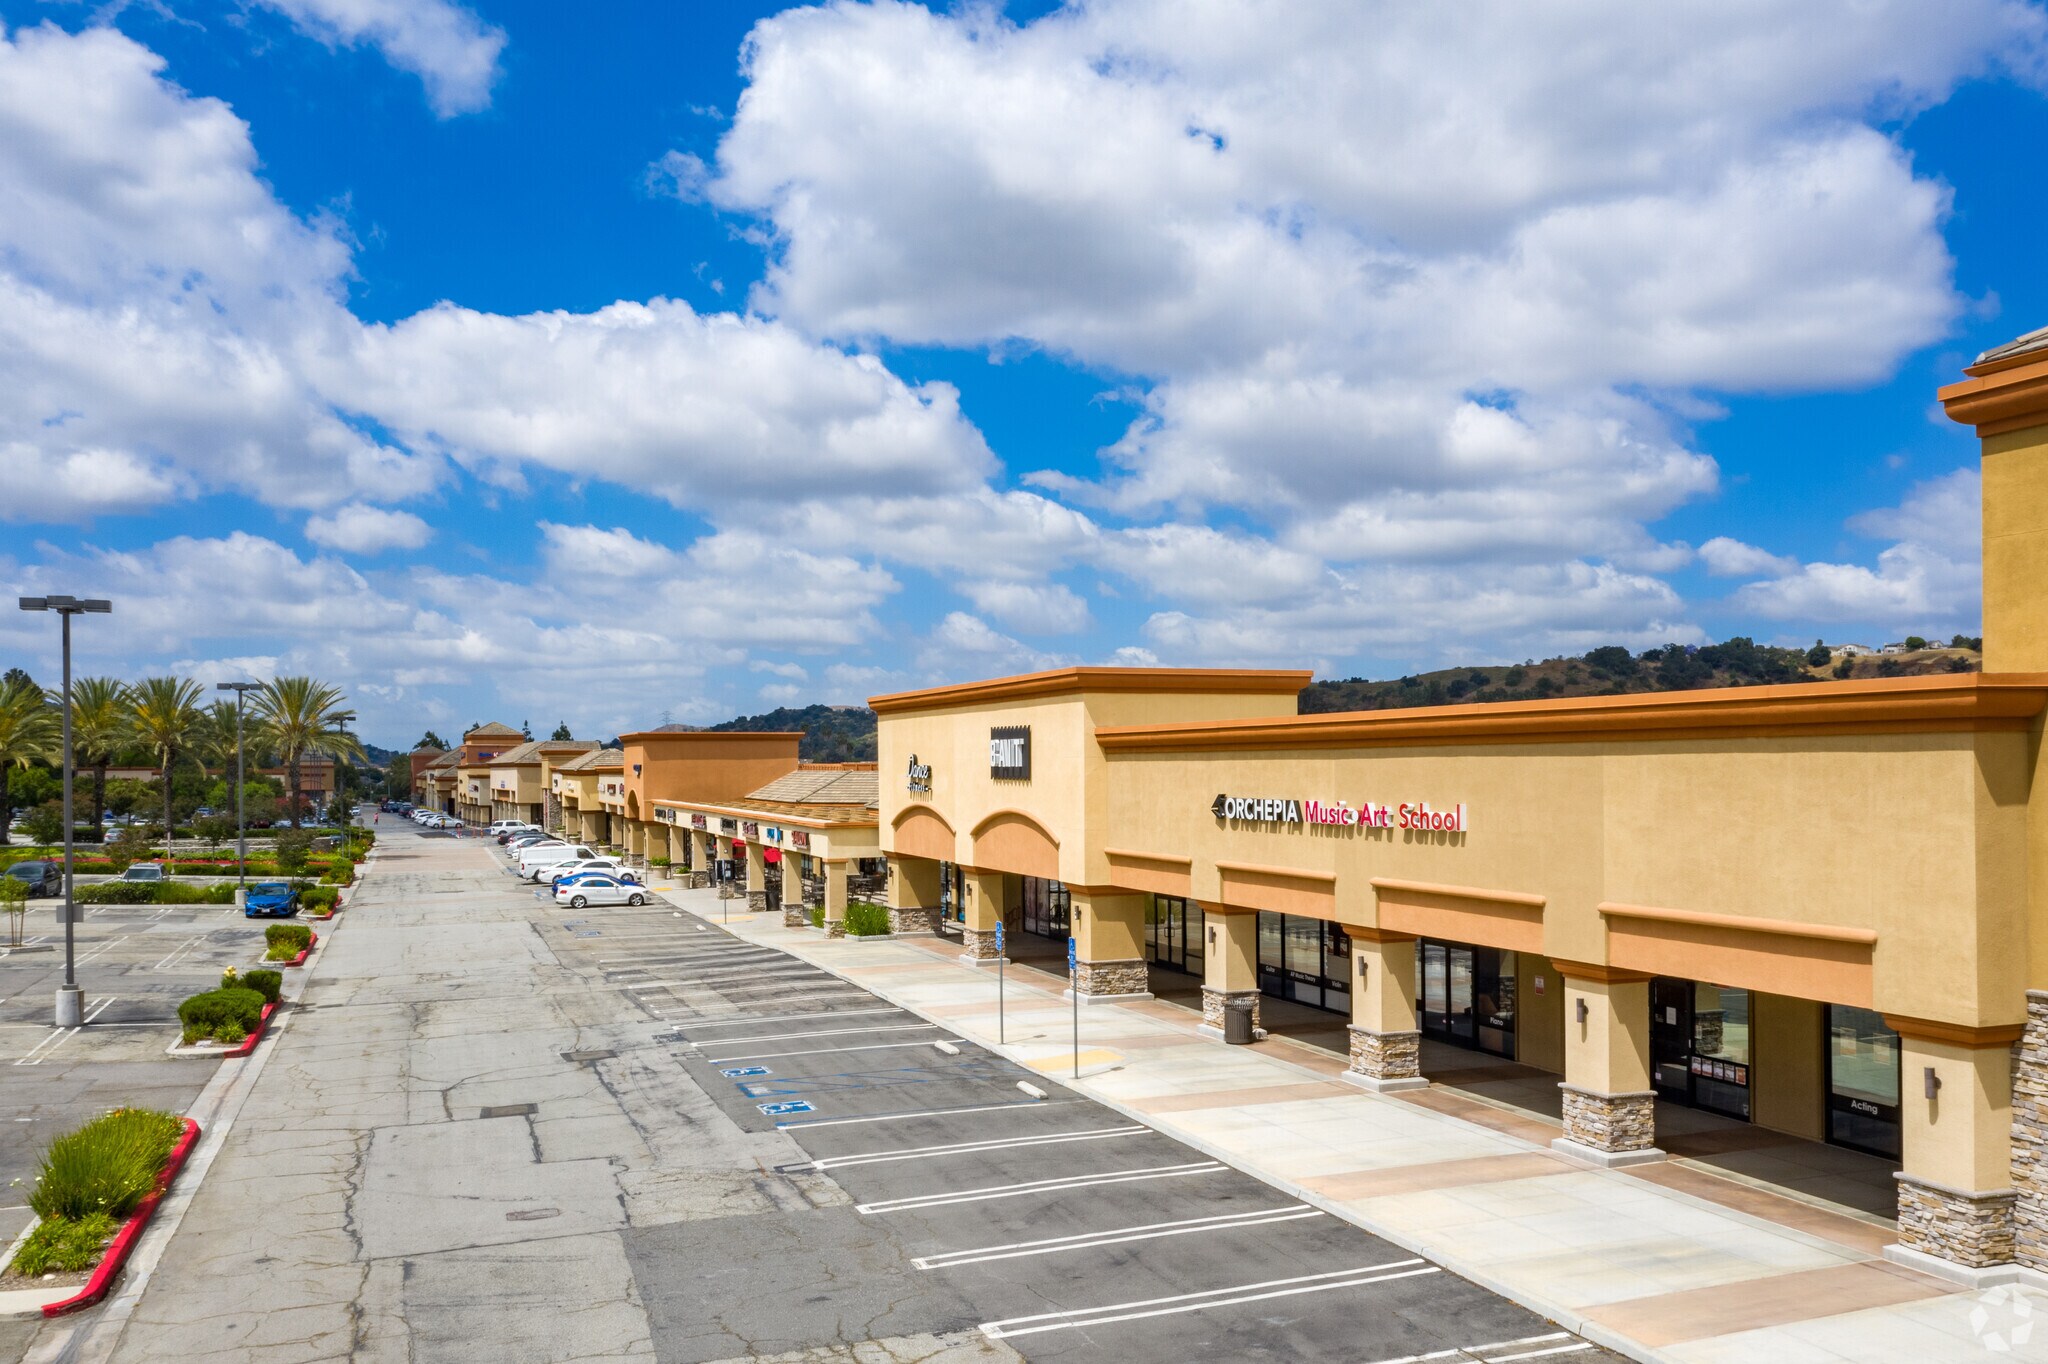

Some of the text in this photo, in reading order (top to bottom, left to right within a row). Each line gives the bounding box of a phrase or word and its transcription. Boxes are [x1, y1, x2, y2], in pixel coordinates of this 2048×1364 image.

[908, 754, 929, 779] Dance
[1224, 798, 1460, 831] ORCHEPIA Music Art School
[1490, 1016, 1504, 1026] Piano
[1851, 1100, 1878, 1115] Acting
